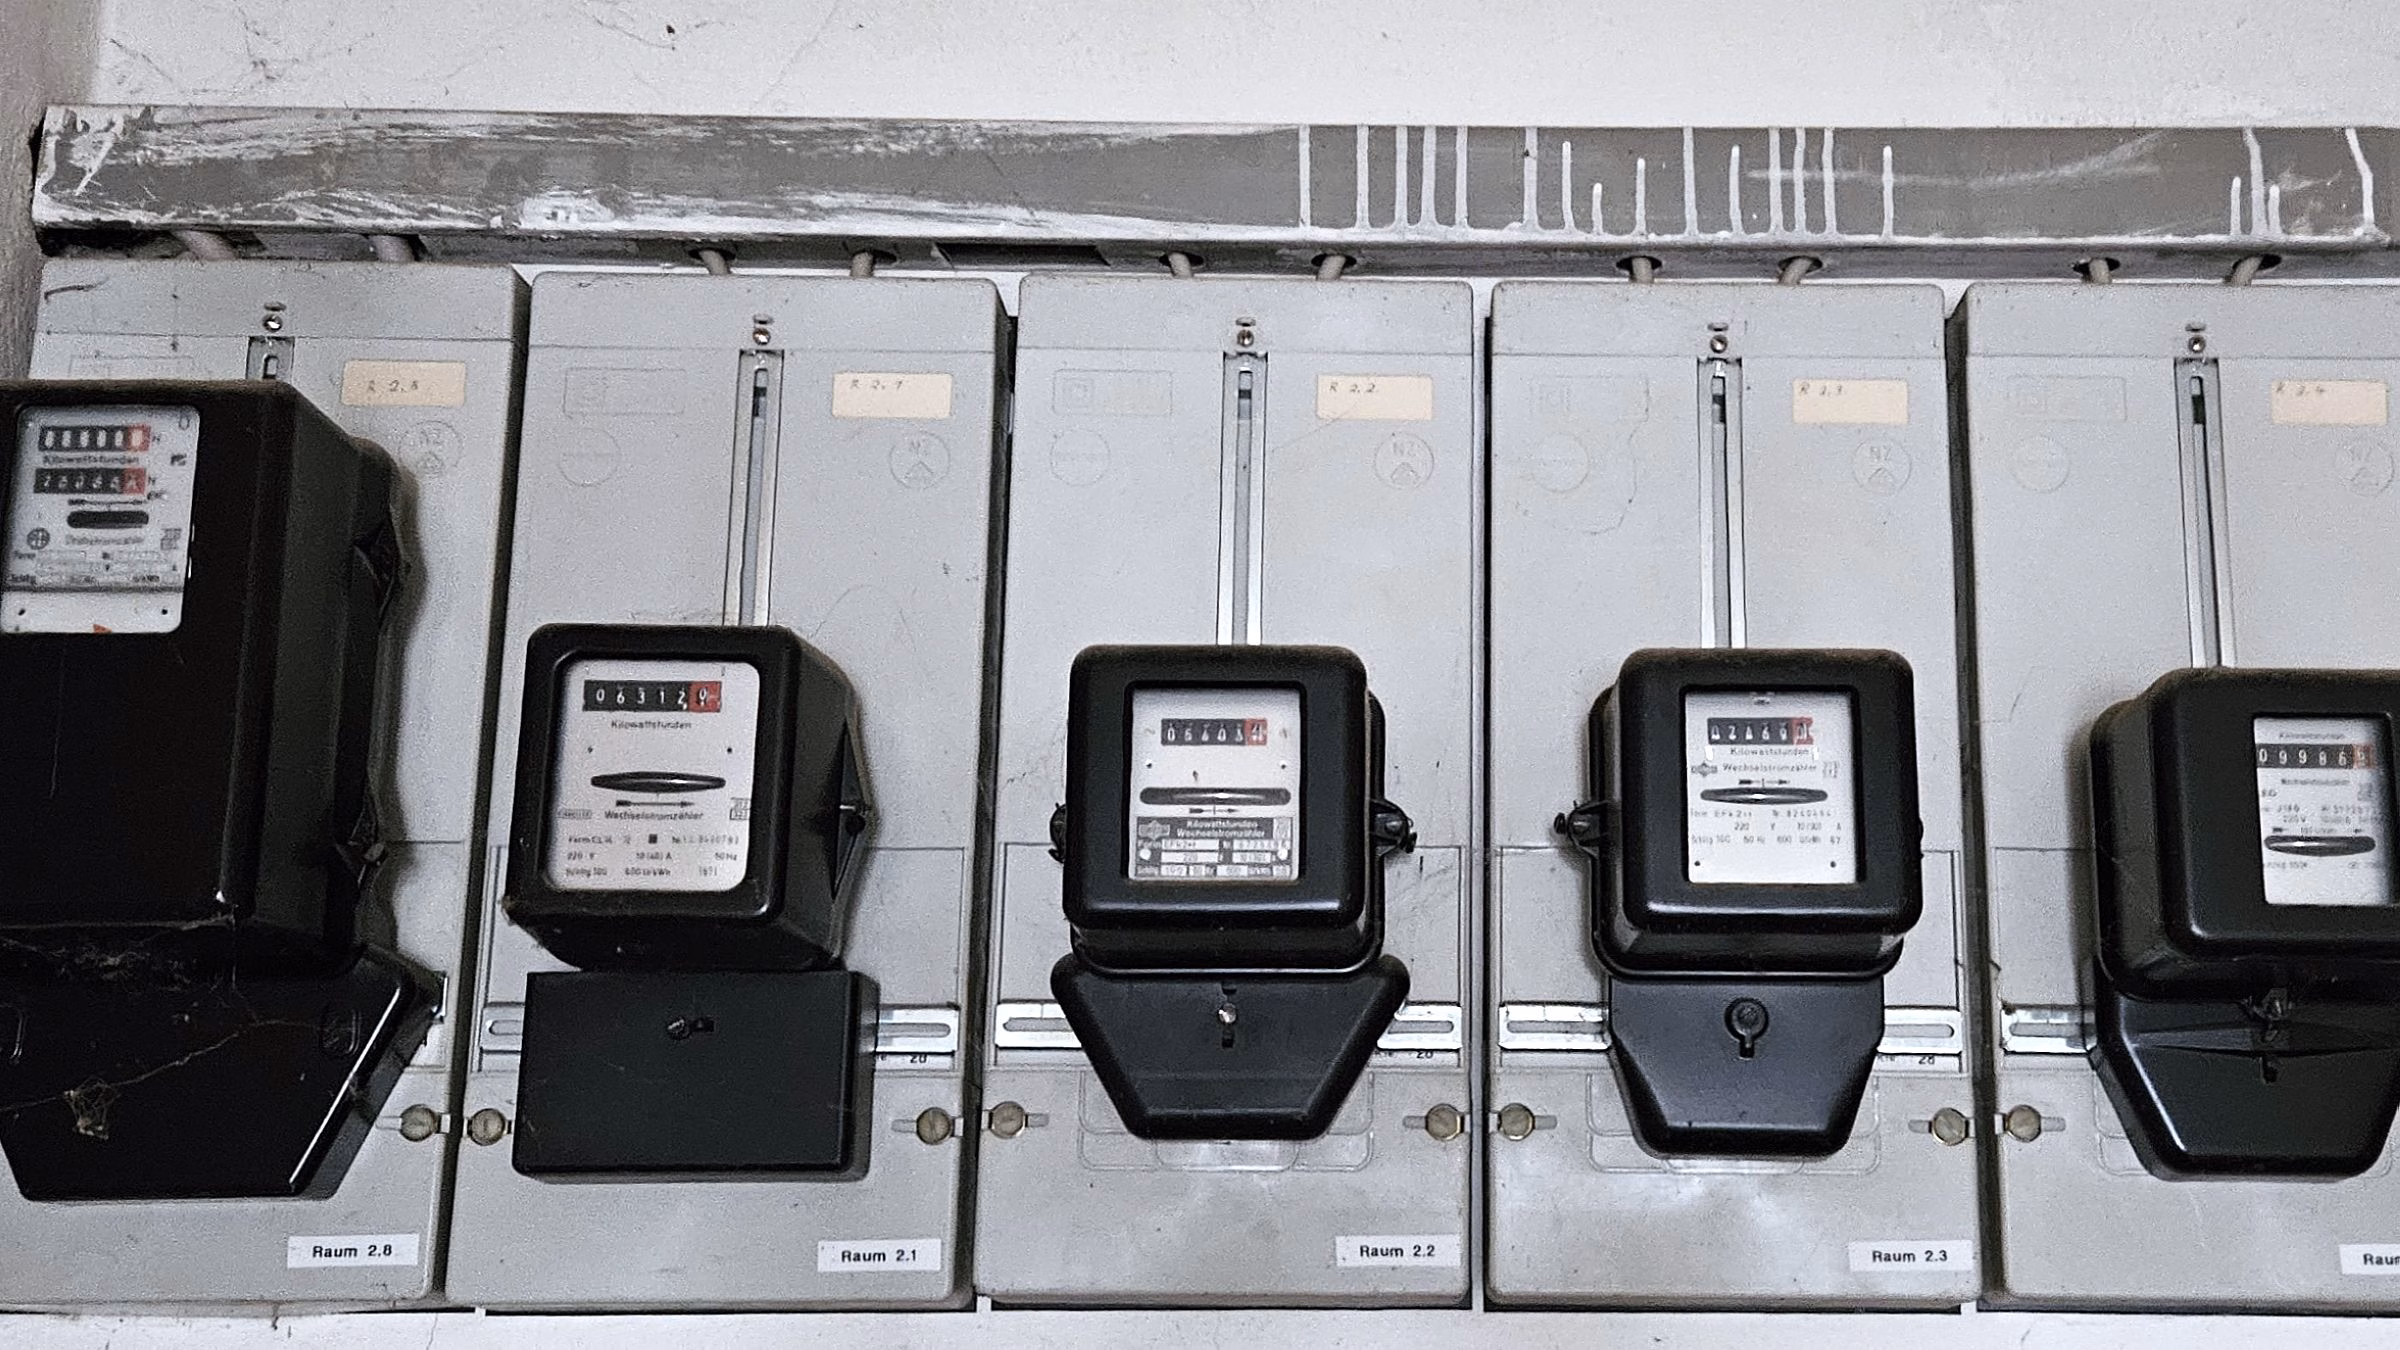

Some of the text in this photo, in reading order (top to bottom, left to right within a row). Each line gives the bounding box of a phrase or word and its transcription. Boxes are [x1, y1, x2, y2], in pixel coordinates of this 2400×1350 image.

[312, 1243, 393, 1258] Raum 2.8
[841, 1248, 917, 1262] Raum 2.1
[1360, 1243, 1436, 1258] Raum 2.2
[1872, 1249, 1948, 1263] Raum 2.3
